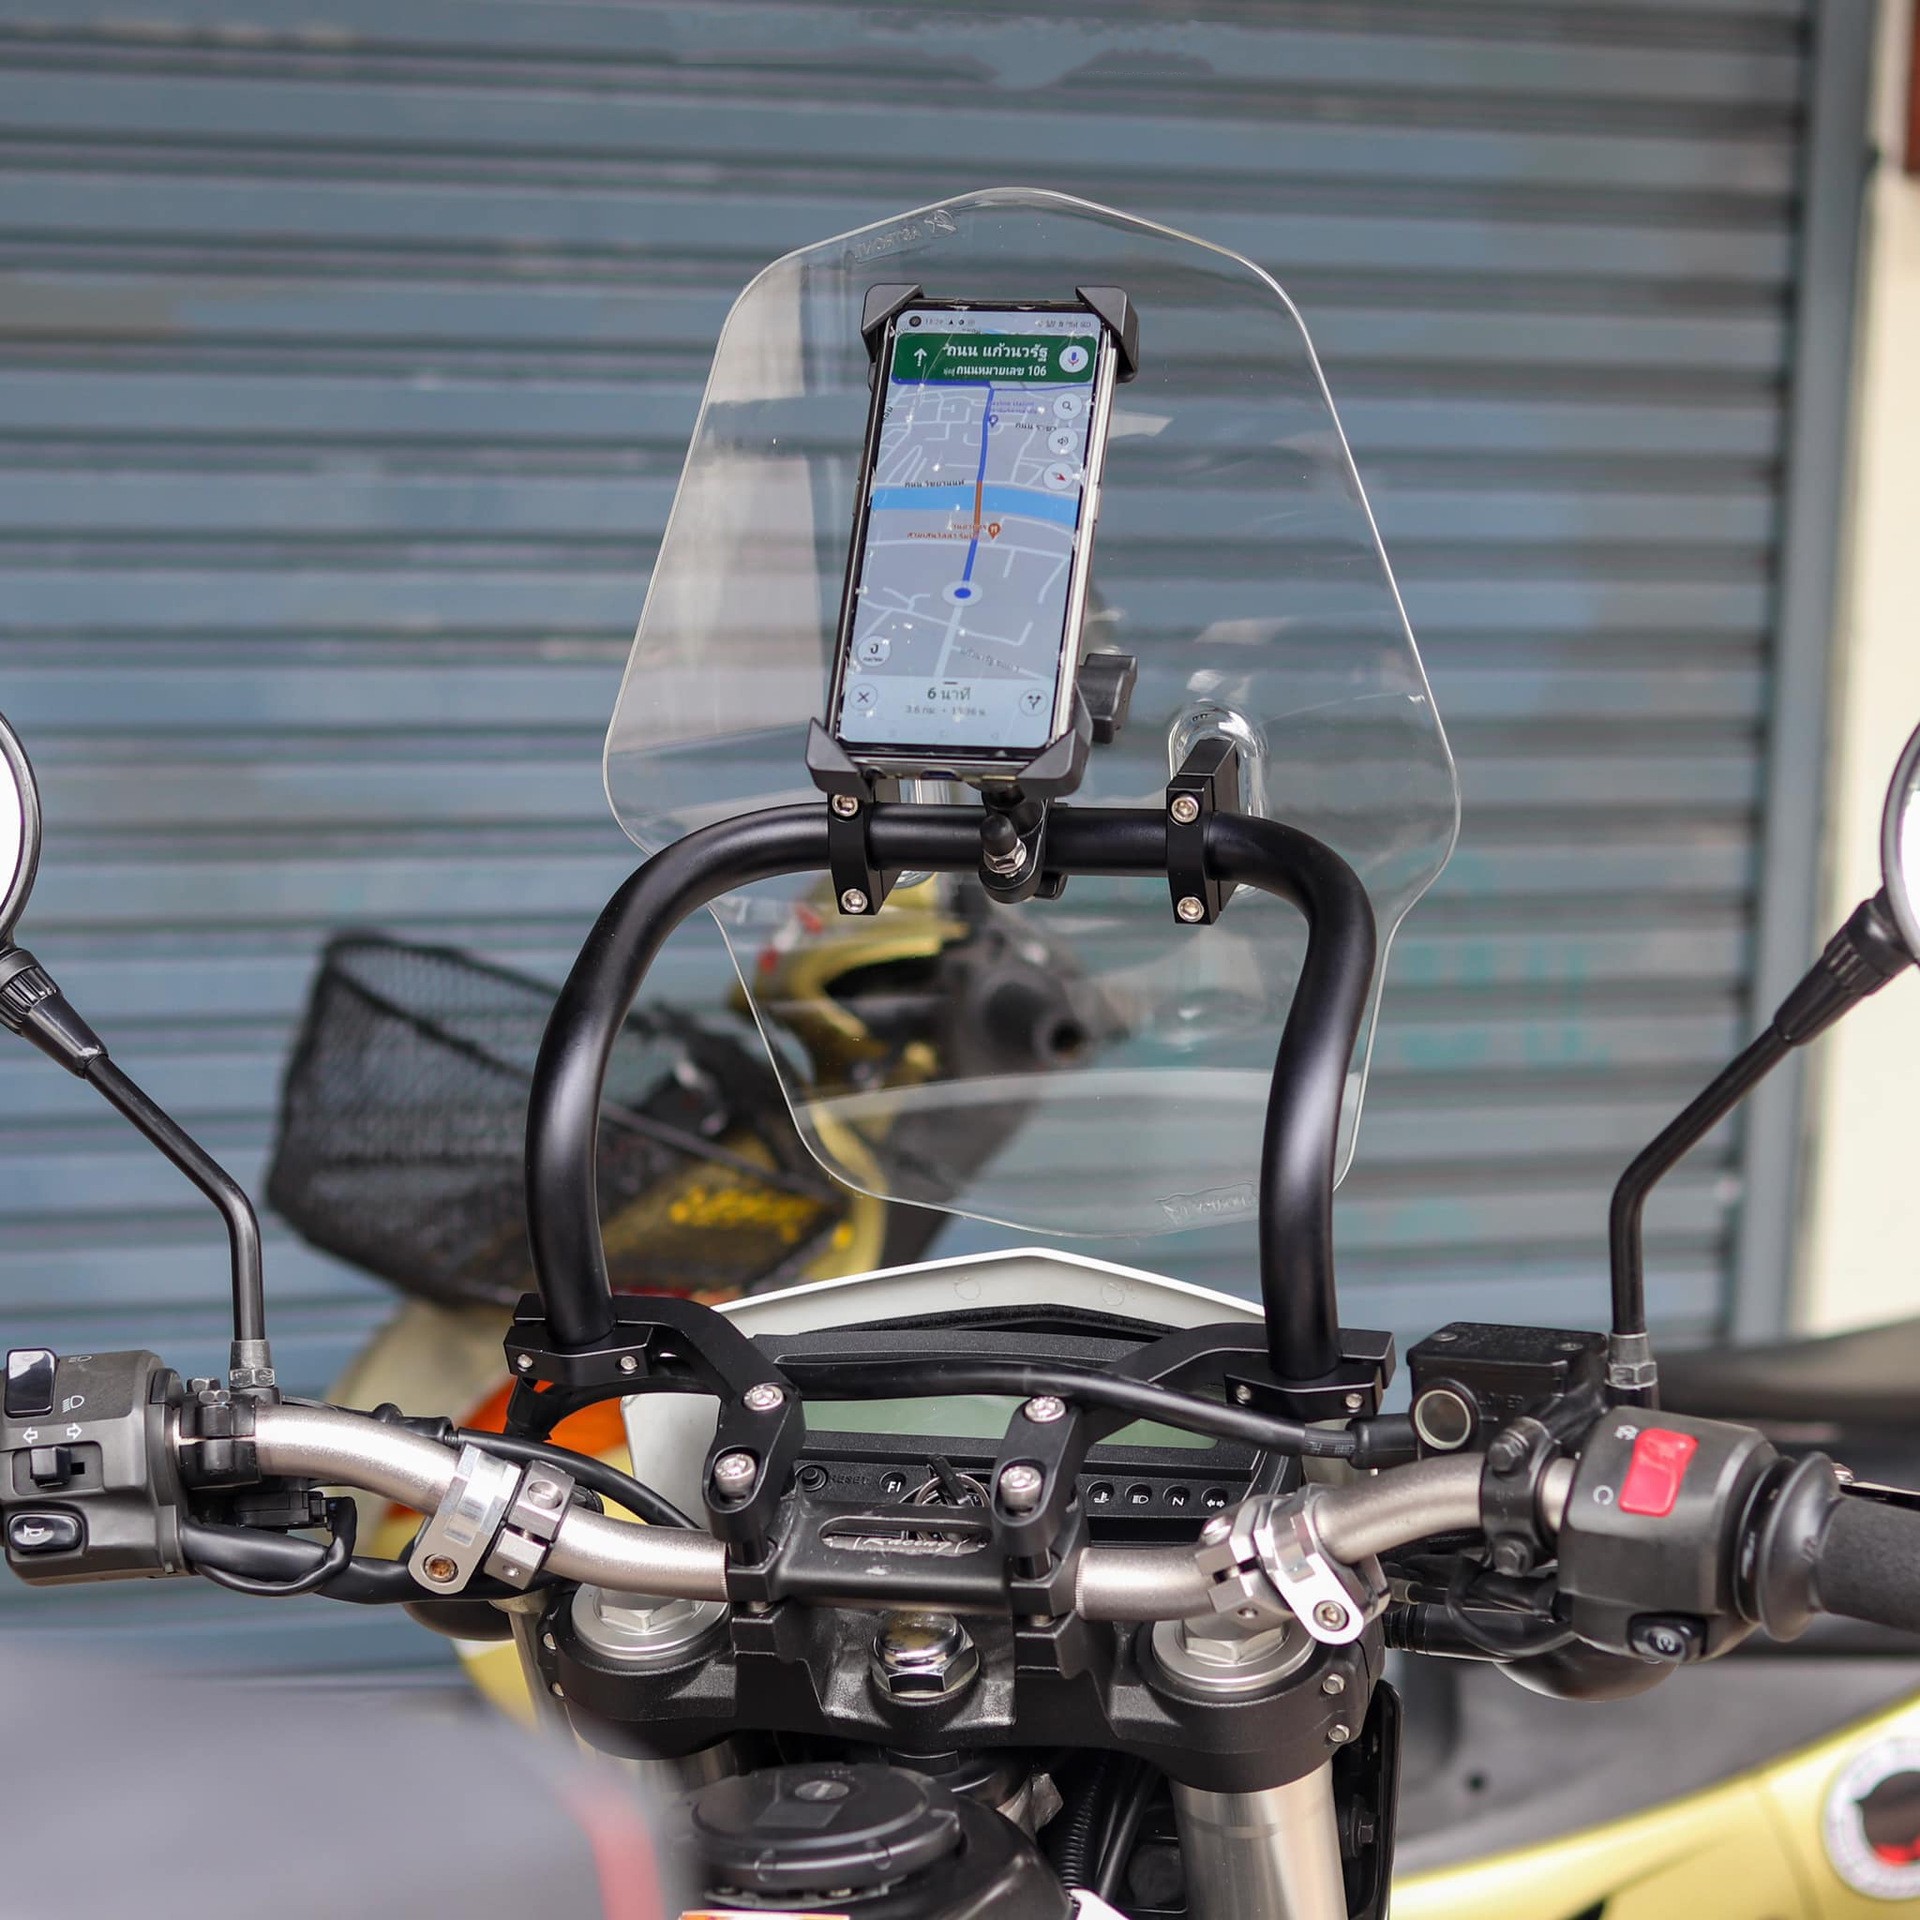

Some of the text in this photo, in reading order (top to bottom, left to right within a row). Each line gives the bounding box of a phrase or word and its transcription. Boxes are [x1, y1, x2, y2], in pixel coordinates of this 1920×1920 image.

[946, 342, 1048, 362] ถนน แก้วนวรัฐ
[1028, 365, 1047, 376] 106
[927, 686, 971, 700] 6 นาที
[887, 1480, 902, 1493] FI
[1171, 1496, 1185, 1507] N
